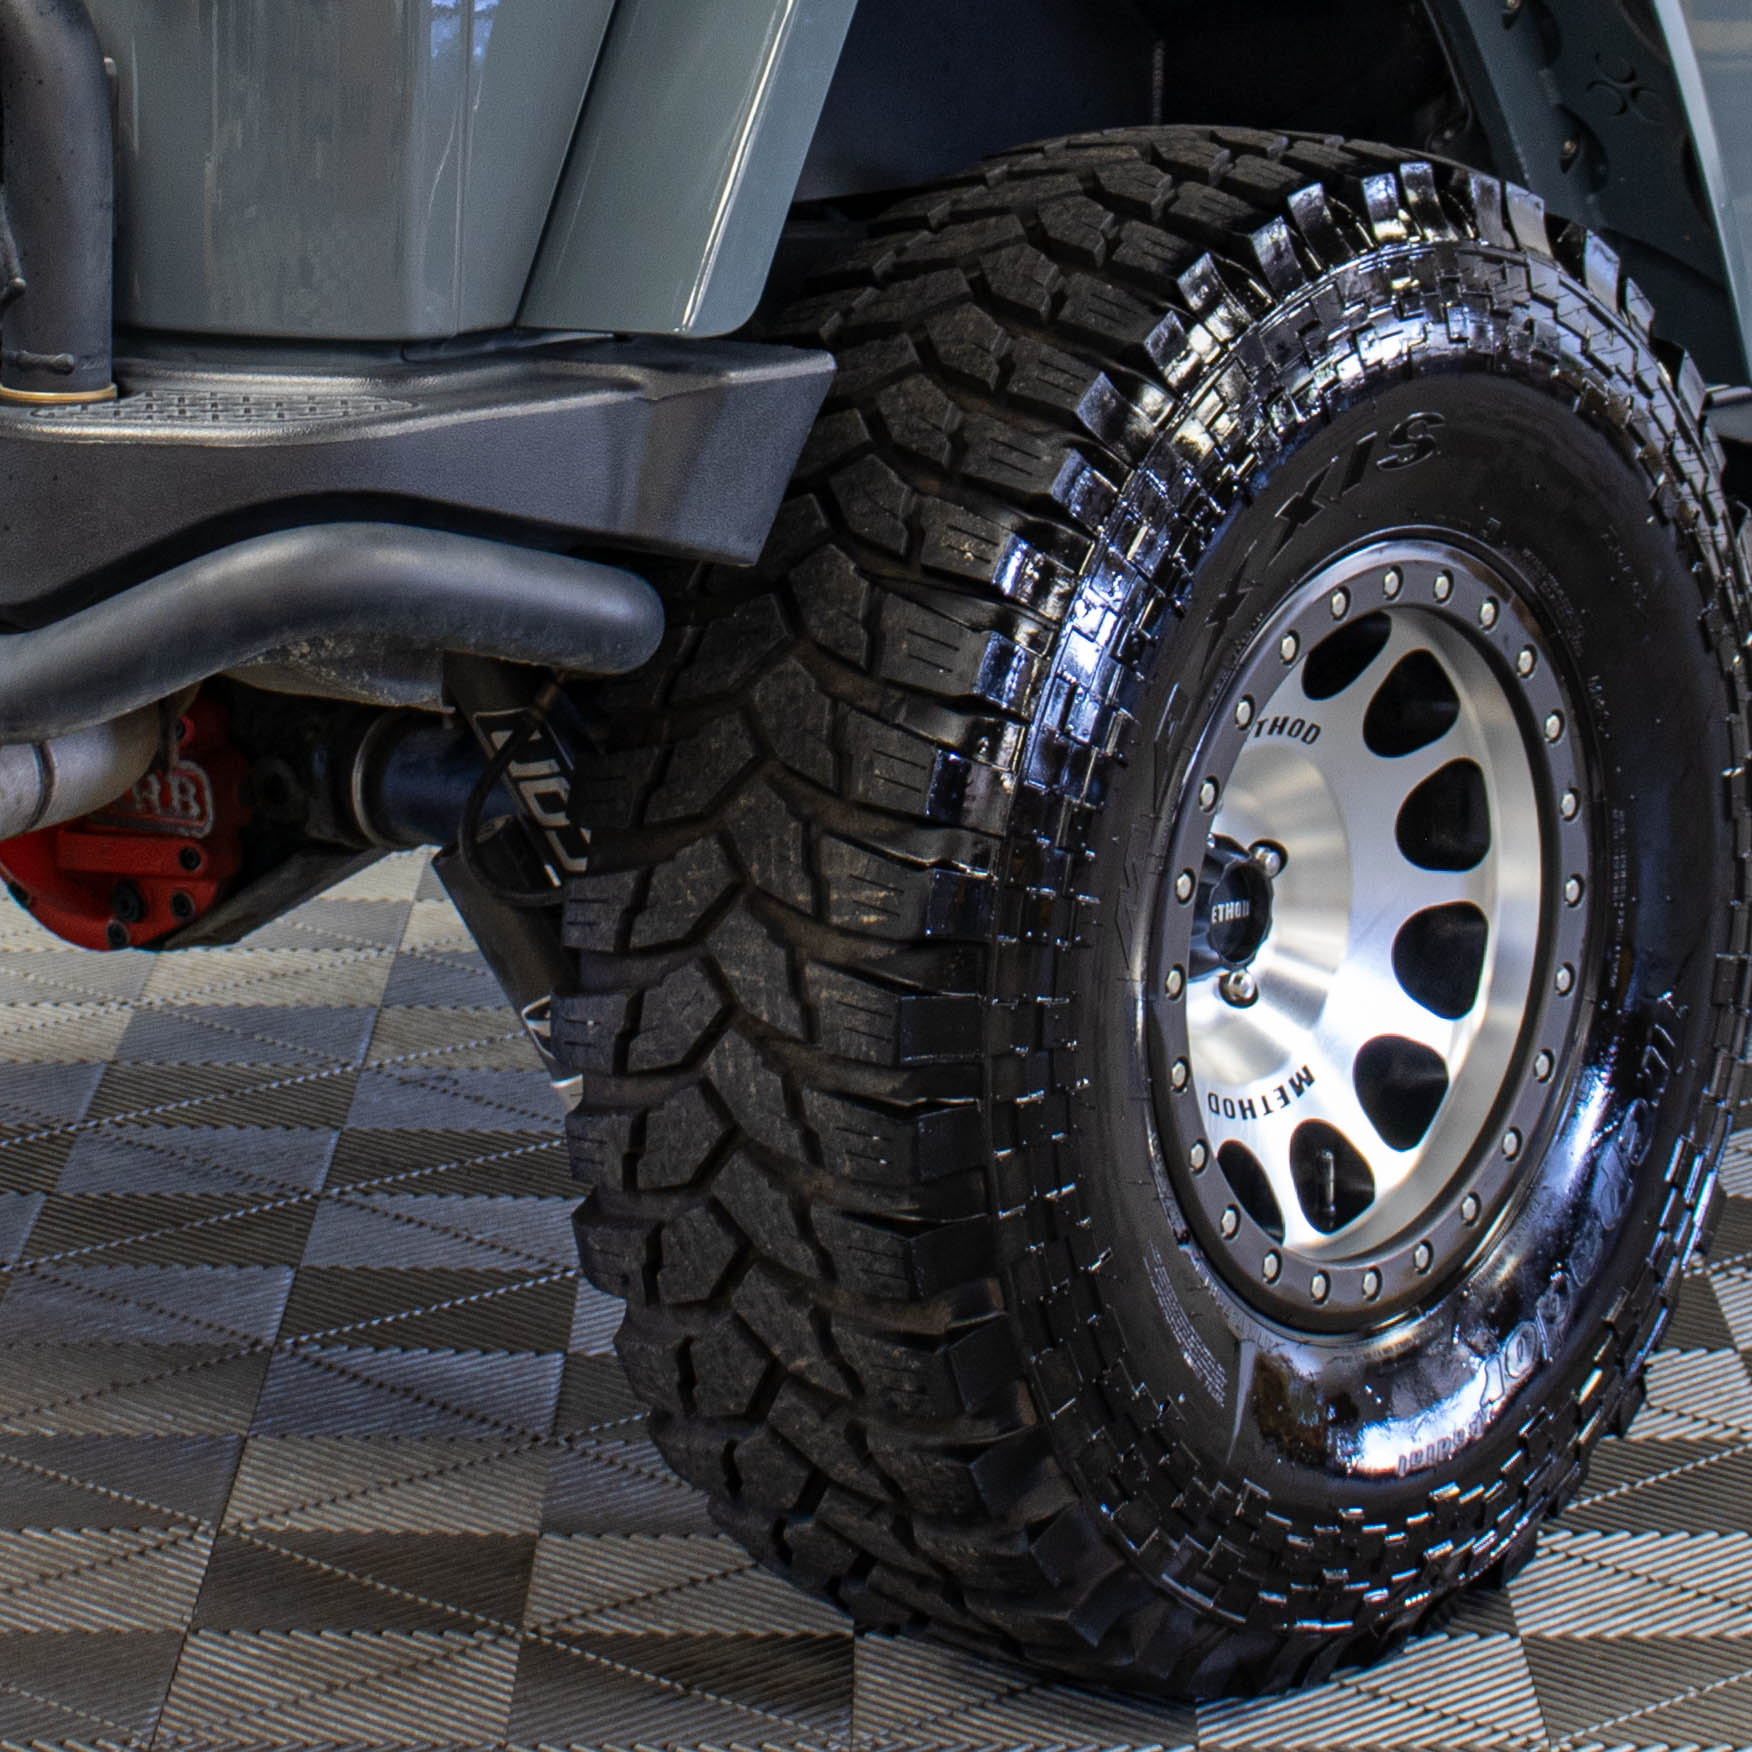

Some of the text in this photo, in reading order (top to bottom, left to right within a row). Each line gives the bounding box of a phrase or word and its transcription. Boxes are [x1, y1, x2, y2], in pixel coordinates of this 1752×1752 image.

[1254, 715, 1321, 745] THOD
[1211, 899, 1252, 924] ETHOD
[1209, 1065, 1315, 1121] METHOD
